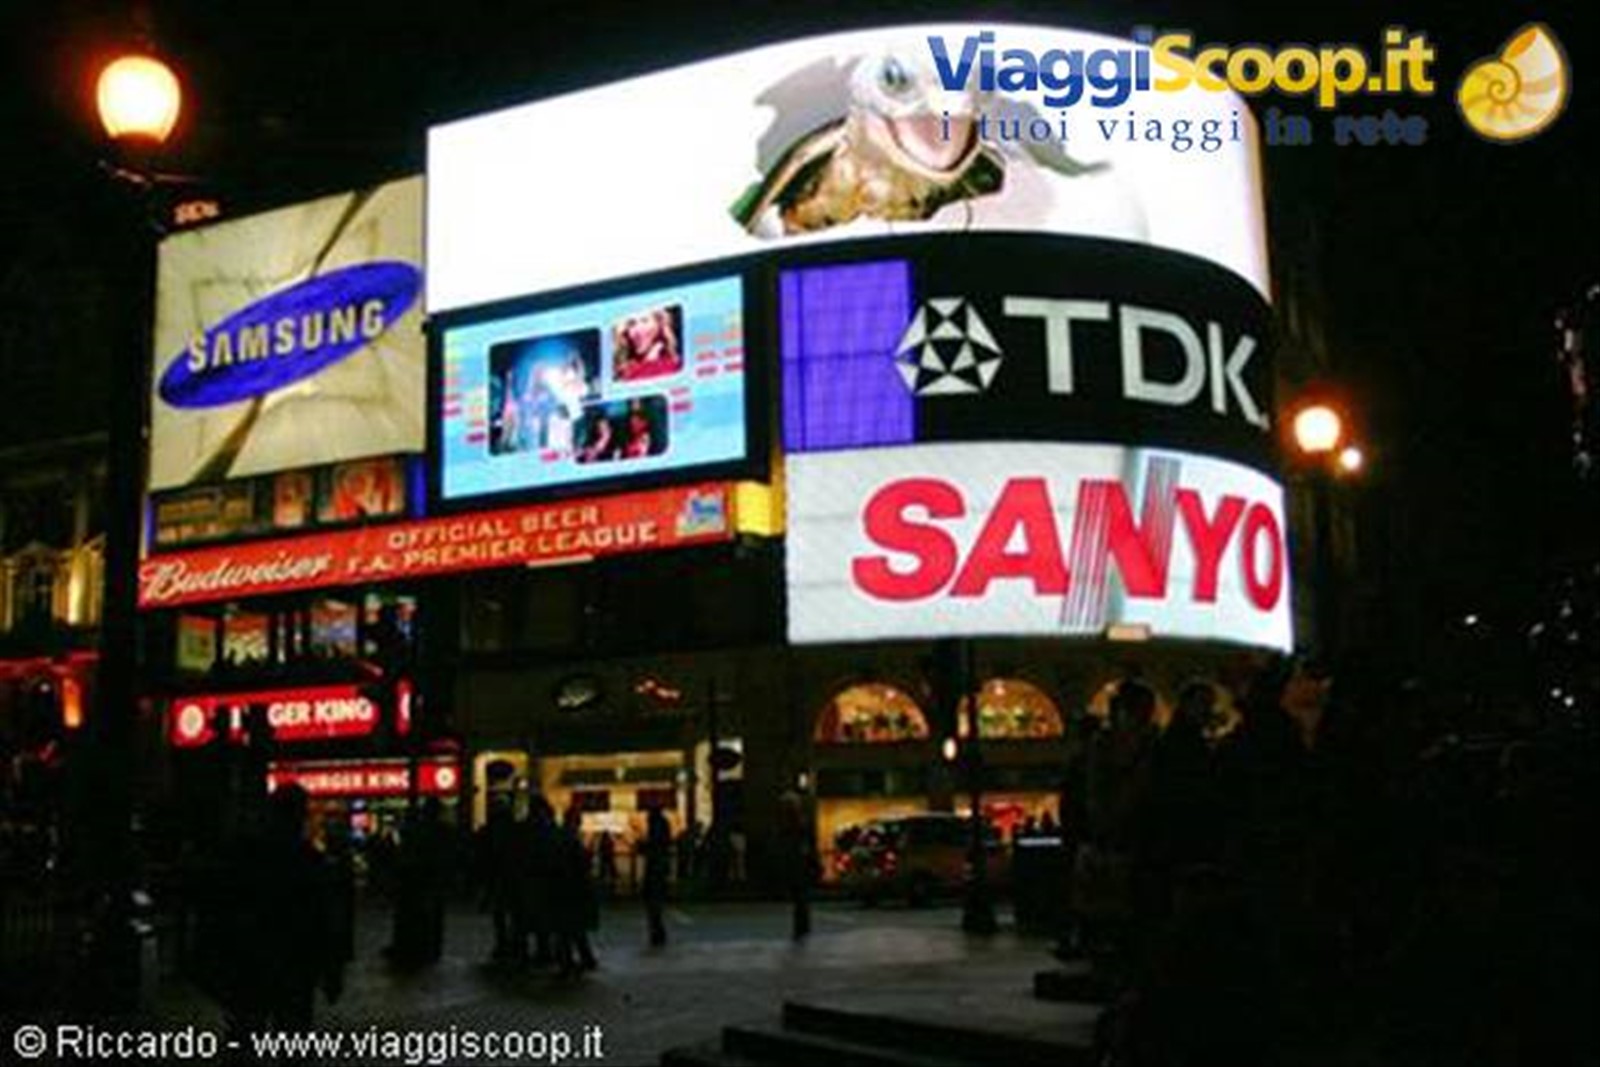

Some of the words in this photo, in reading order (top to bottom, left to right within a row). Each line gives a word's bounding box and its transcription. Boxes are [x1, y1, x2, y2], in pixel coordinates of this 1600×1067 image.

[187, 299, 385, 373] SAMSUNG
[1002, 296, 1268, 430] TDK
[388, 518, 504, 550] OFFICIAL
[521, 506, 600, 534] BEER
[402, 541, 526, 568] PREMIER
[537, 522, 658, 554] LEAGUE
[851, 476, 1283, 620] SANYO
[140, 552, 333, 602] Budweiser
[267, 703, 311, 727] GER
[315, 698, 374, 722] KING
[298, 769, 363, 789] URGER
